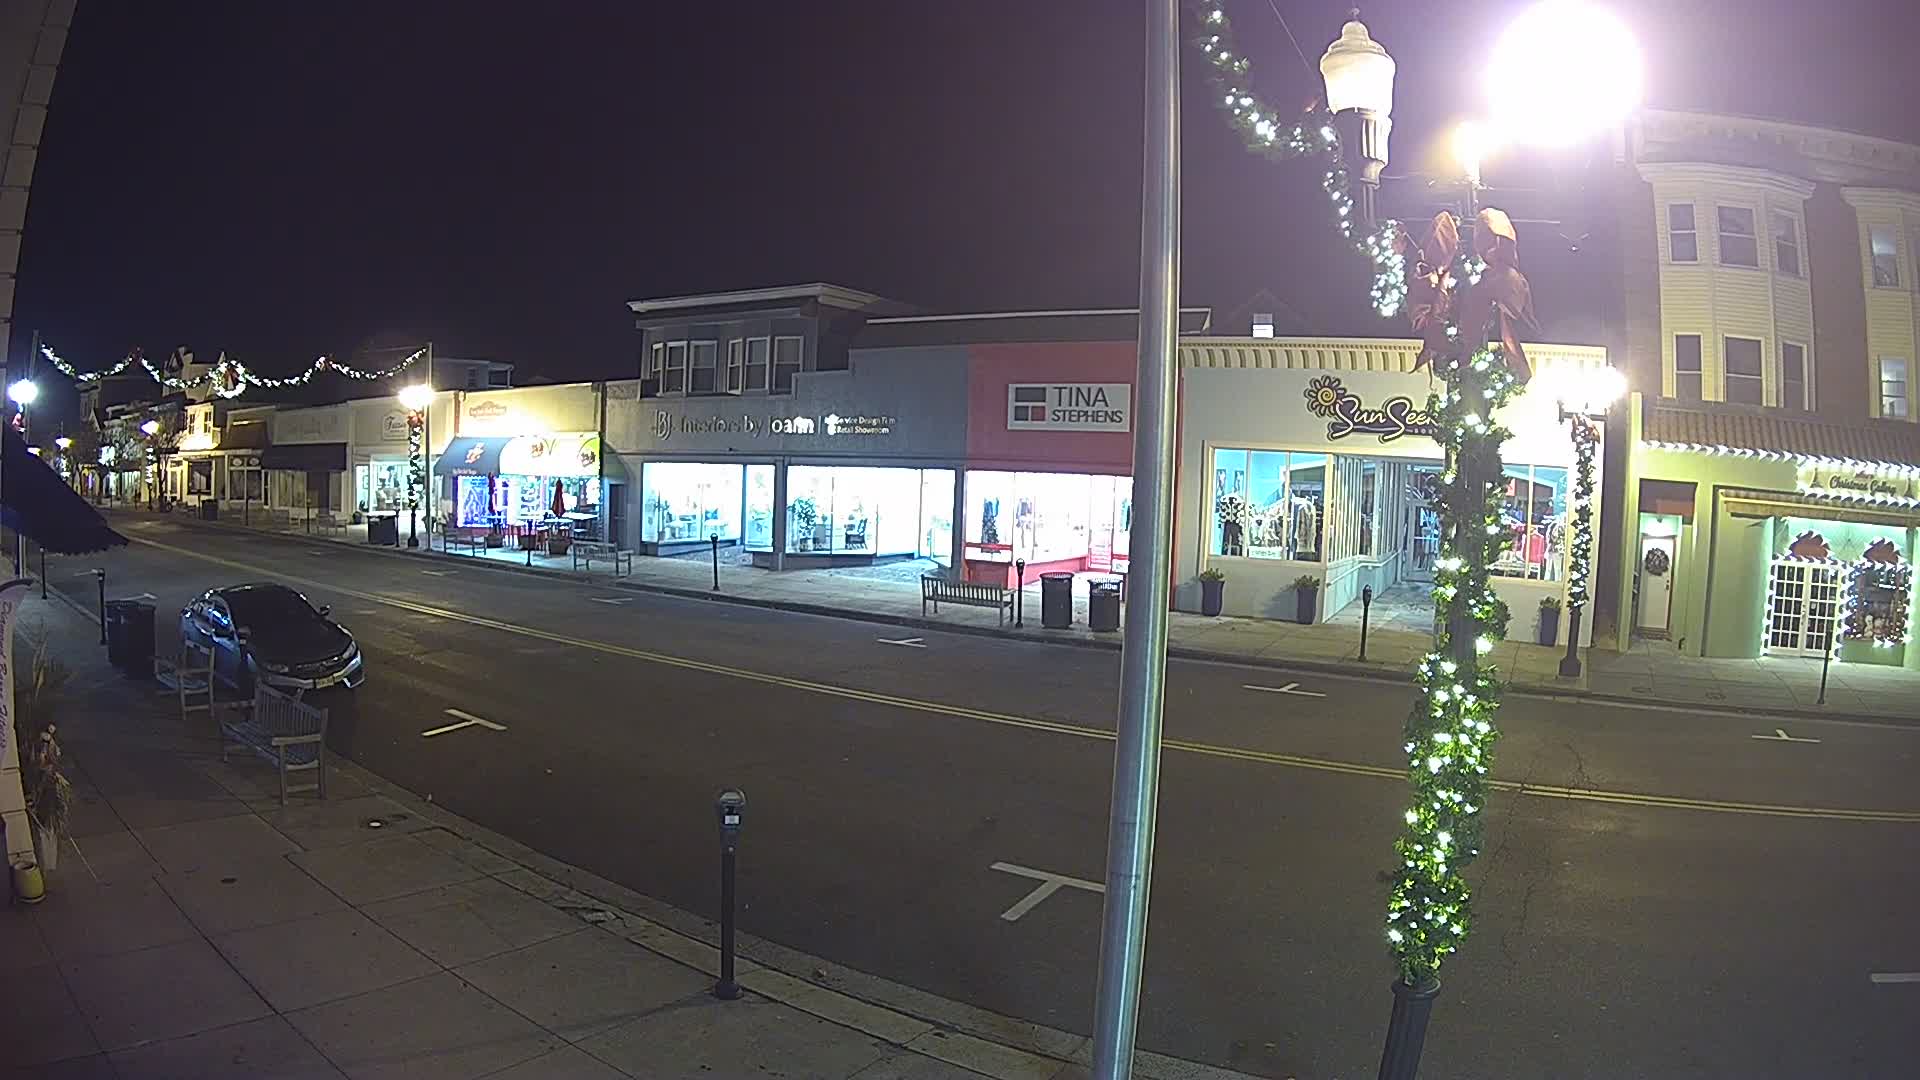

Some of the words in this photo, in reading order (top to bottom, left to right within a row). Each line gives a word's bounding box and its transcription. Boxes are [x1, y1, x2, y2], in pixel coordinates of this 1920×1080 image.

[1052, 386, 1110, 408] TINA
[743, 415, 764, 438] by
[1051, 408, 1123, 424] STEPHENS
[1332, 396, 1387, 439] Sun
